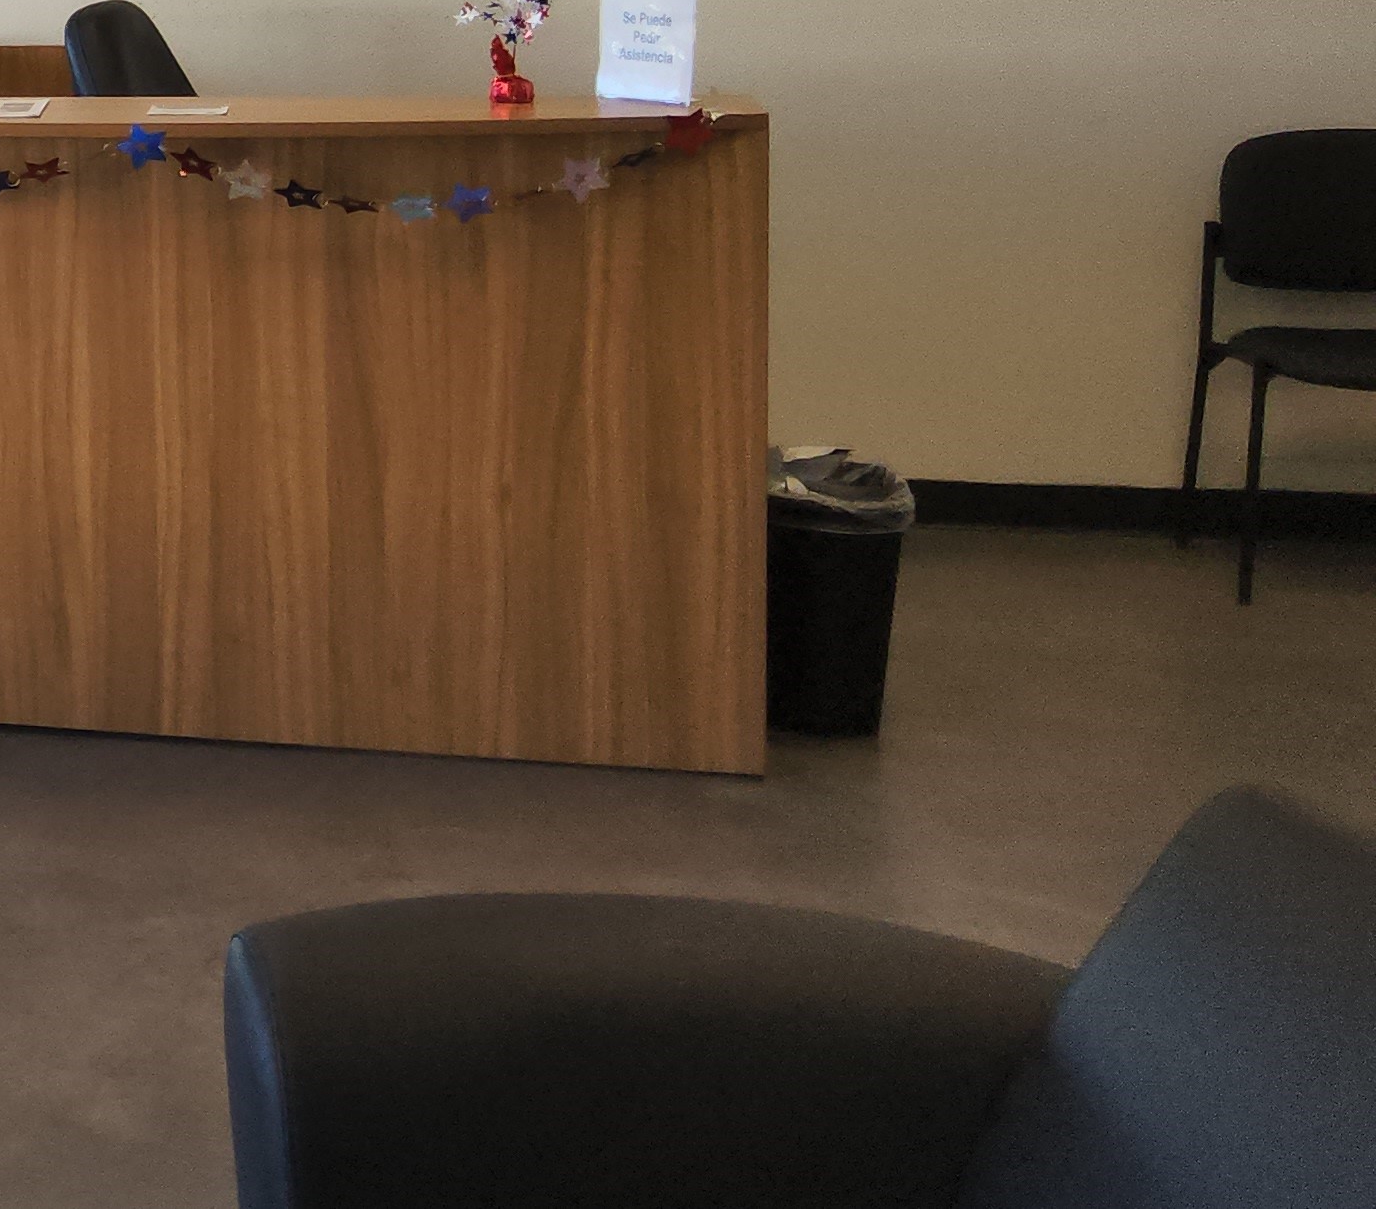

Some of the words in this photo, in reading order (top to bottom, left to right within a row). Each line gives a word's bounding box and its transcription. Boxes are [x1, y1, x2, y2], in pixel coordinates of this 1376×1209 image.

[623, 11, 636, 24] Se
[639, 12, 672, 27] Puede
[618, 47, 674, 63] Asistencia
